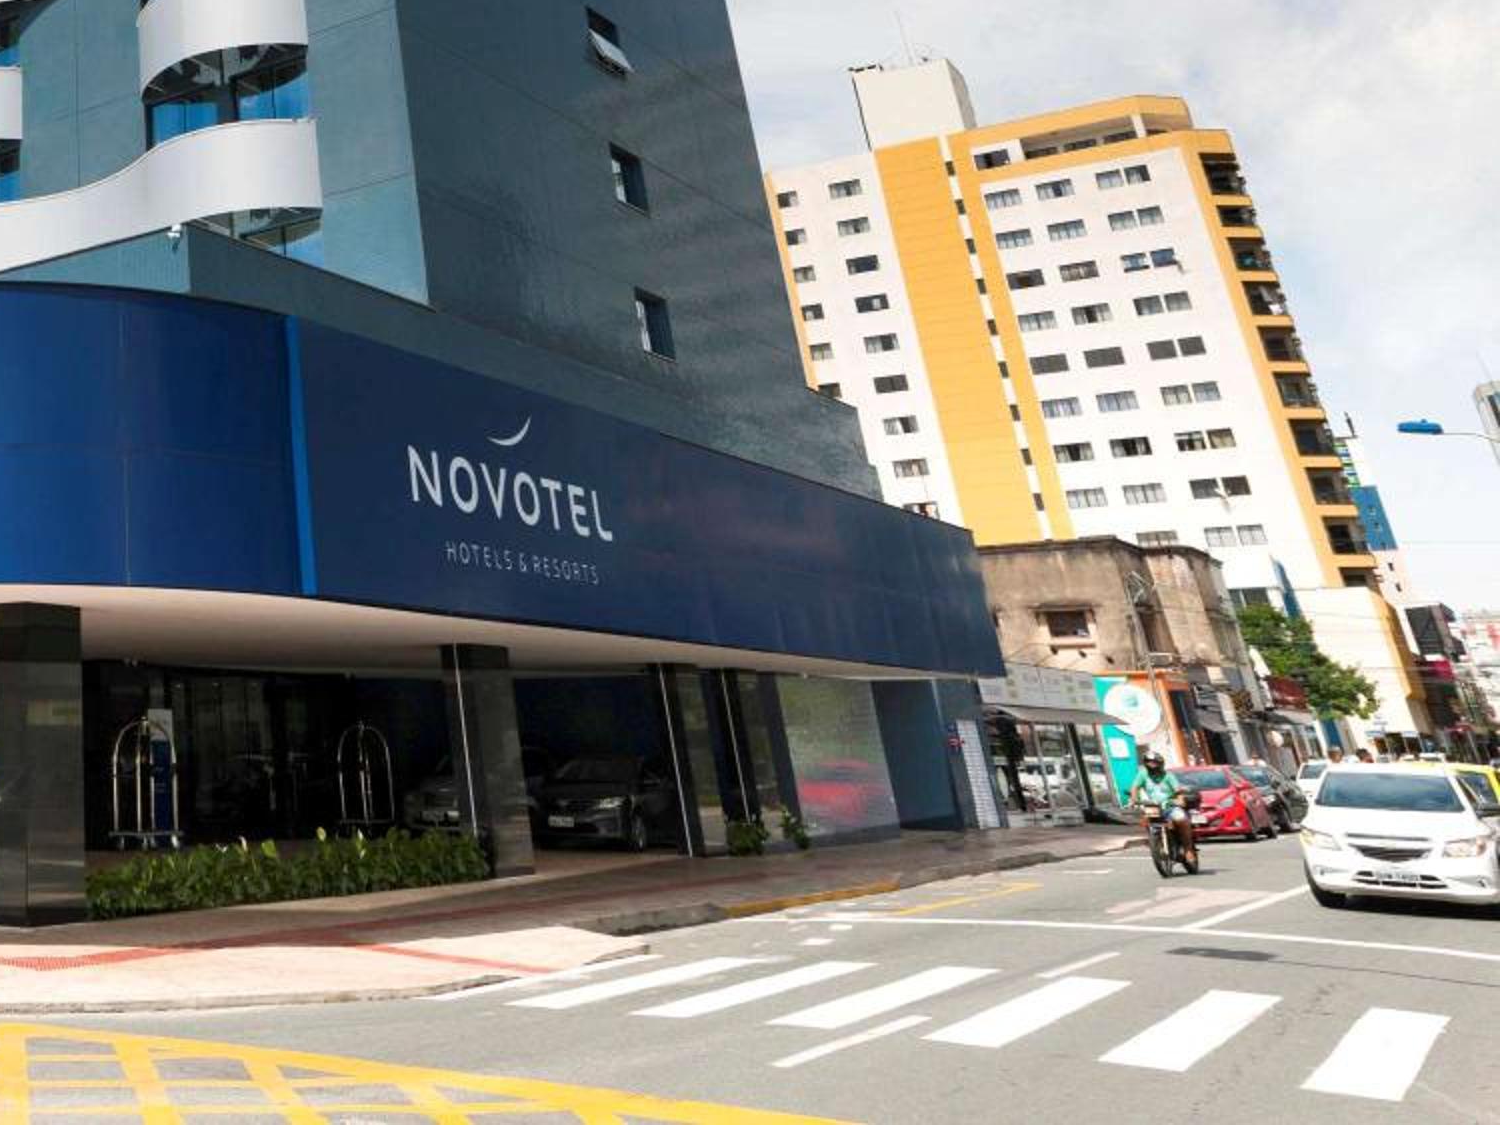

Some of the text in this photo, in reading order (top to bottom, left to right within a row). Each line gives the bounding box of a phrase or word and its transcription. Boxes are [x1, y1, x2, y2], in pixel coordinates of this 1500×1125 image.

[407, 444, 613, 542] NOVOTEL
[446, 541, 600, 585] HOTELS & RESORTS
